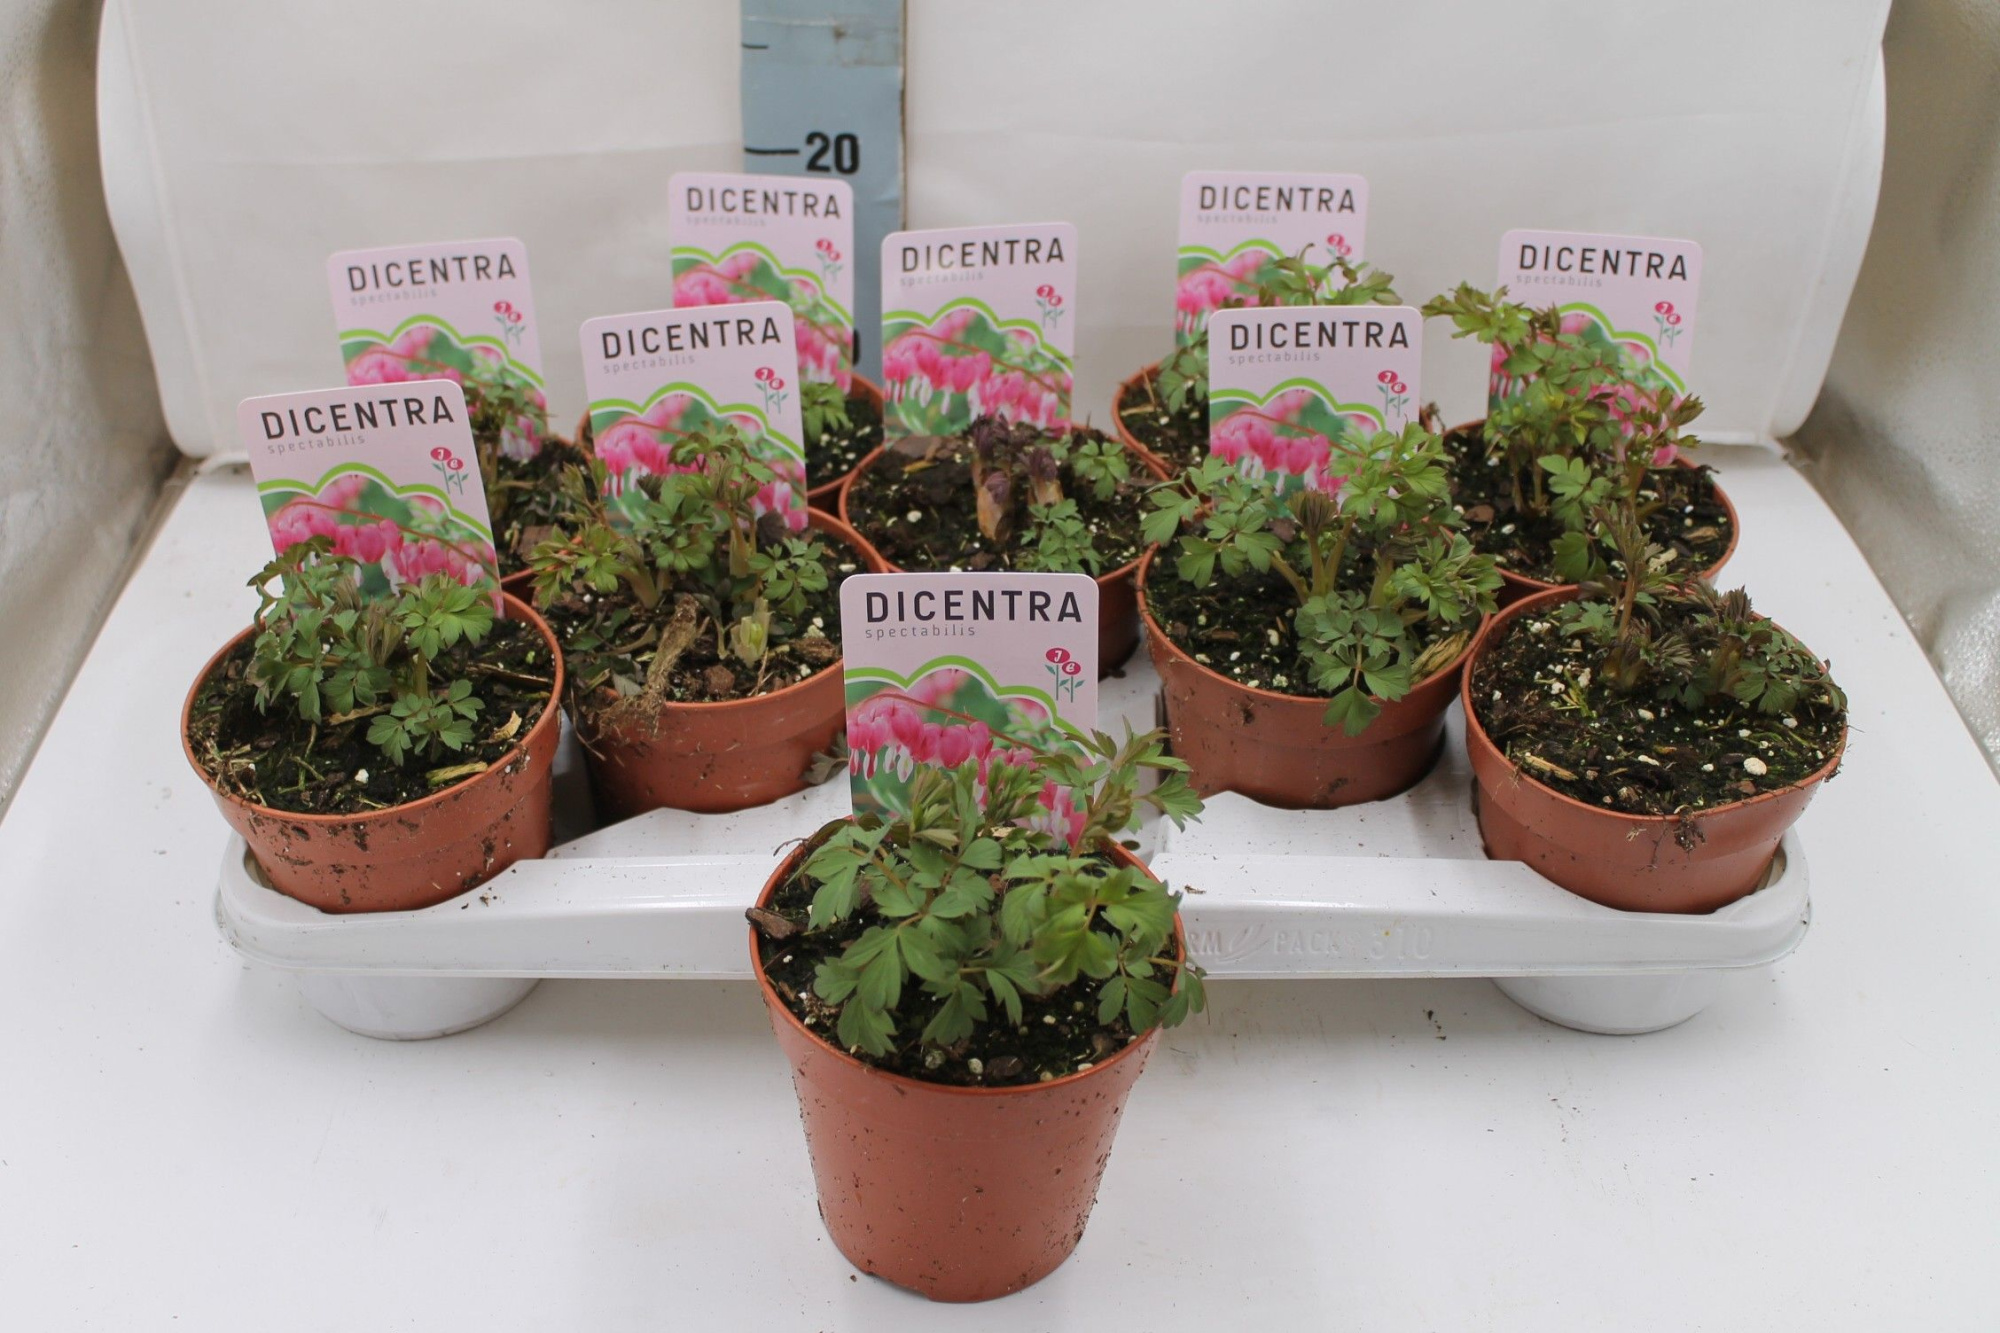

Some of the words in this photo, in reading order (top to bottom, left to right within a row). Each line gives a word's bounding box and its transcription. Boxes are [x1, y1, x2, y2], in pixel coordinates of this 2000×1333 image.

[806, 131, 860, 175] 20
[686, 187, 841, 219] DICENTRA
[1200, 186, 1356, 214] DICENTRA
[902, 237, 1065, 273] DICENTRA
[1519, 244, 1687, 281] DICENTRA
[347, 253, 516, 292] DICENTRA
[602, 317, 781, 360] DICENTRA
[1231, 321, 1409, 351] DICENTRA
[603, 354, 696, 374] spectabilis
[1229, 351, 1321, 366] spectabilis
[261, 395, 454, 440] DICENTRA
[267, 433, 366, 456] spectabilis
[865, 590, 1082, 623] DICENTRA
[865, 624, 976, 641] spectabilis
